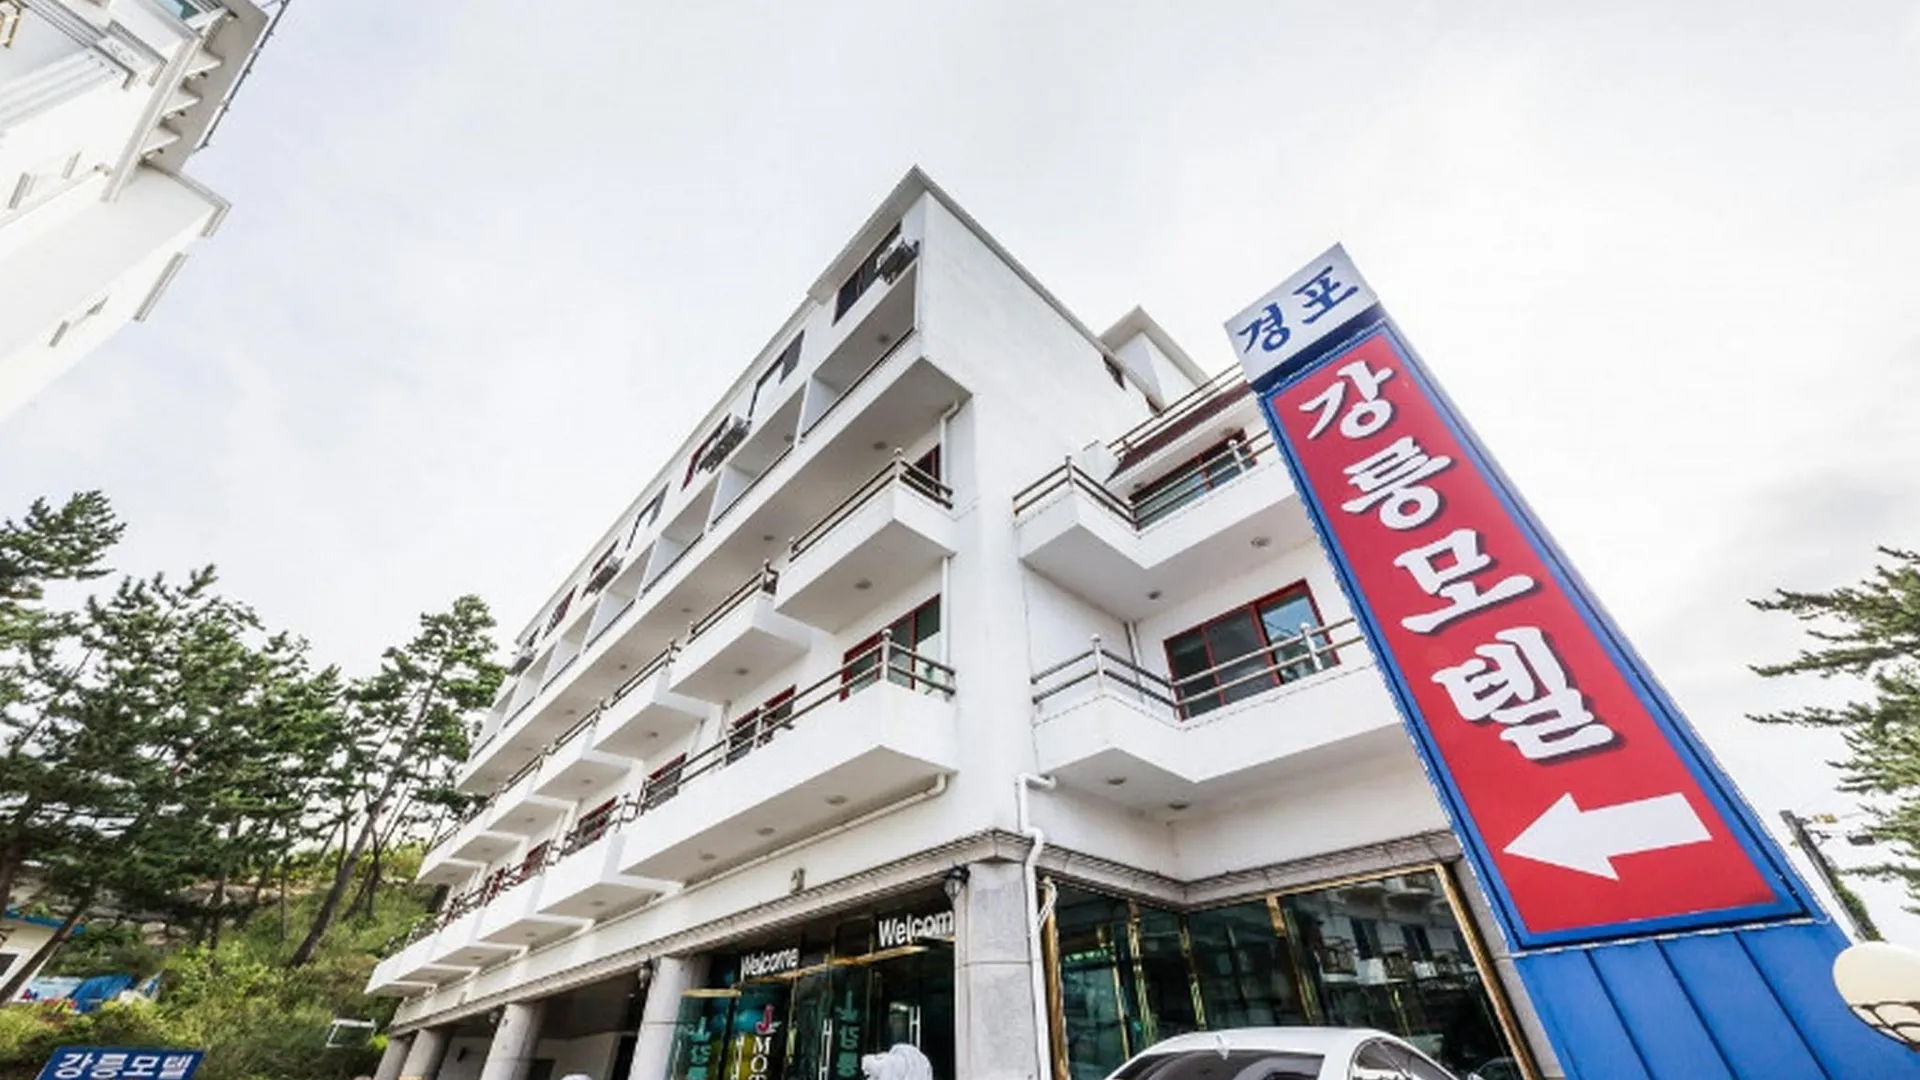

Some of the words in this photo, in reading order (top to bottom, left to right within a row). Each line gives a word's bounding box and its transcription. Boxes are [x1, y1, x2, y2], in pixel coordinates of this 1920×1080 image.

[1238, 266, 1358, 353] 경포
[1299, 361, 1615, 761] 강릉모텔
[740, 948, 799, 980] Welcome
[54, 1052, 194, 1079] 강릉모텔
[748, 1036, 772, 1080] MO
